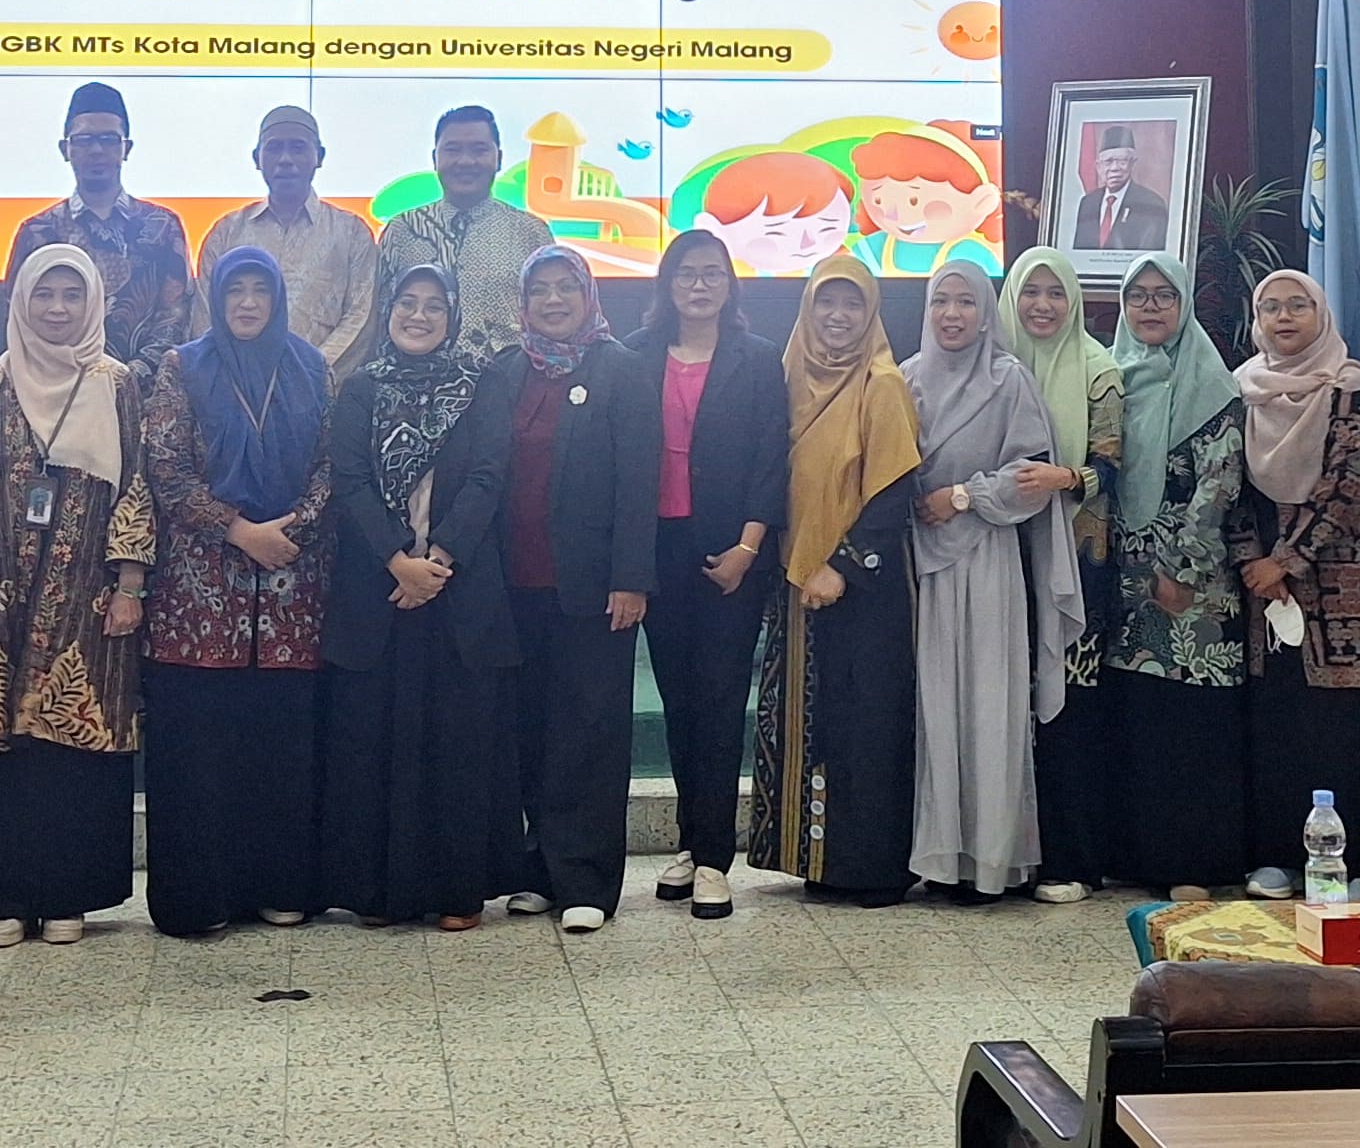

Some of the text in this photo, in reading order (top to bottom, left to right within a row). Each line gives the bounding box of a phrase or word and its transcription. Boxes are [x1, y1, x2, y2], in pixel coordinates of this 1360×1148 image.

[71, 37, 124, 53] MTs
[134, 37, 199, 54] Kota
[208, 37, 316, 59] Malang
[325, 38, 432, 60] dengan
[440, 38, 585, 57] Universitas
[593, 40, 682, 61] Negeri
[690, 41, 793, 63] Malang
